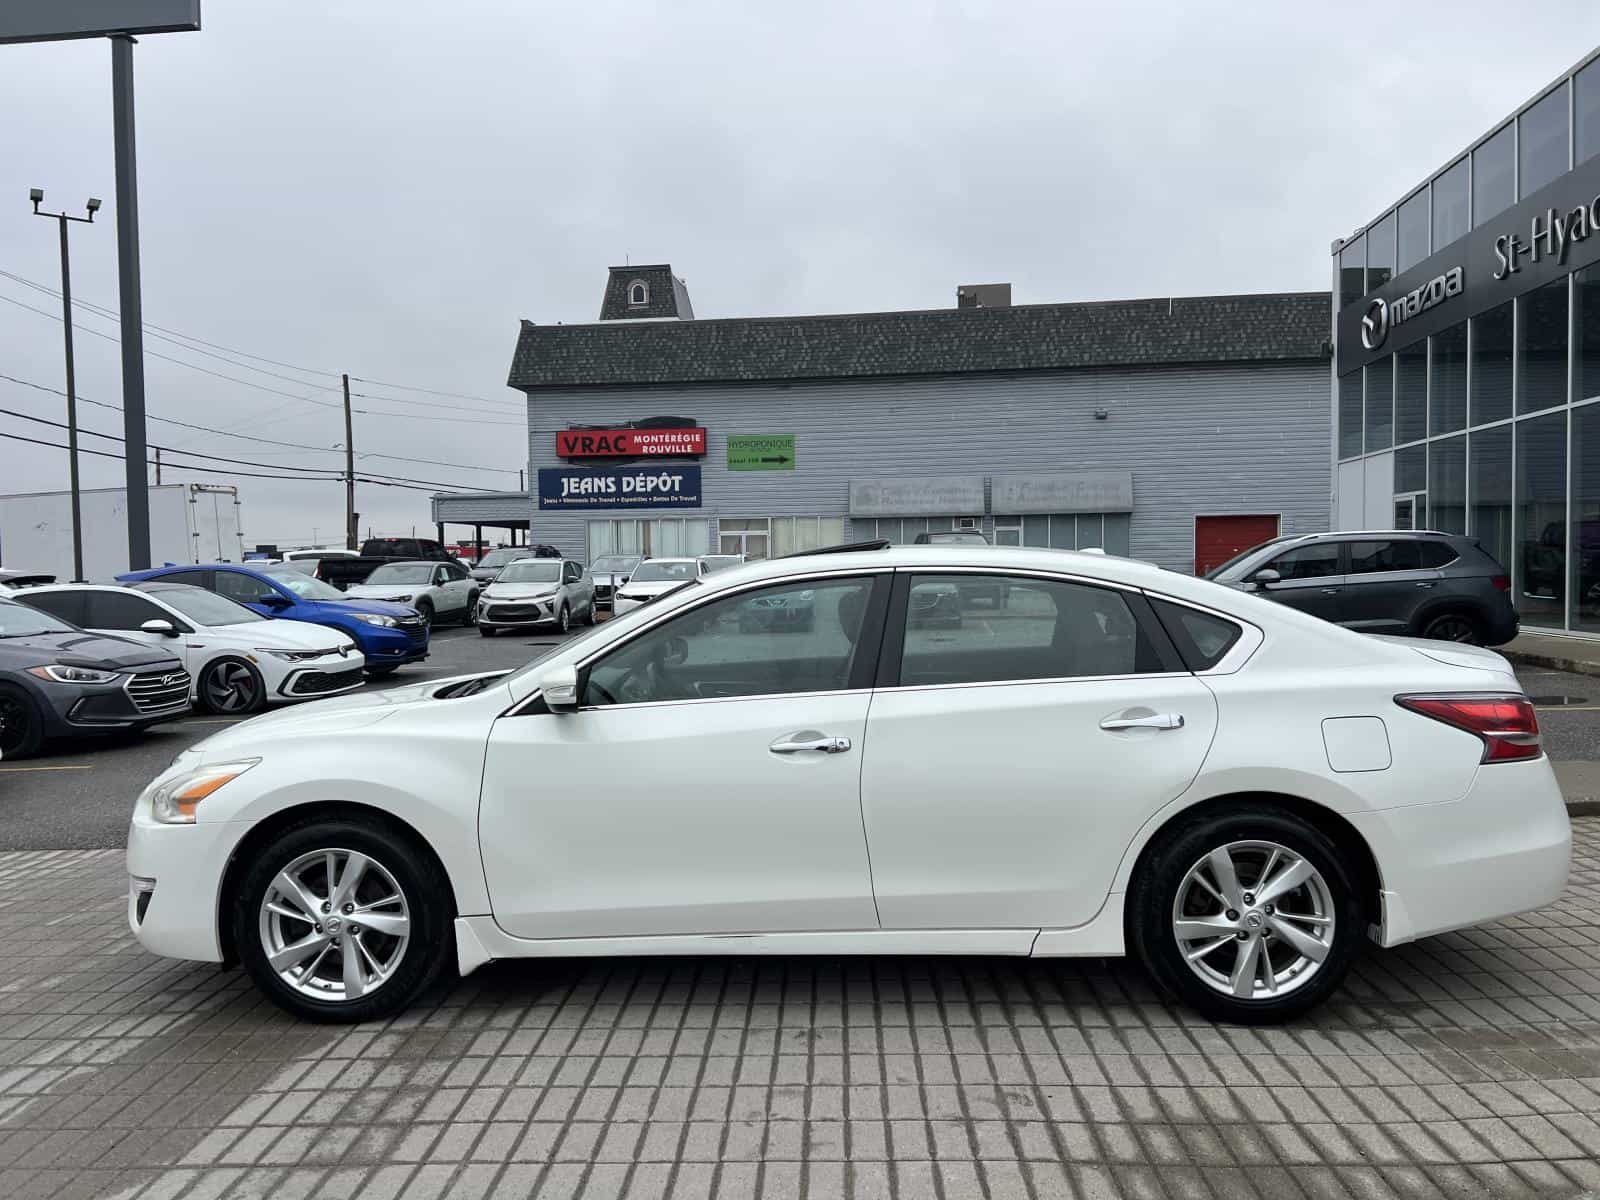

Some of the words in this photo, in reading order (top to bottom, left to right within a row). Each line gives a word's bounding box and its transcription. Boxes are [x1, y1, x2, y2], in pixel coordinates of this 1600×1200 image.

[1391, 266, 1462, 325] mazda
[563, 435, 627, 454] VRAC
[634, 433, 700, 443] MONTÉRÉGIE
[642, 444, 693, 454] ROUVILLE
[561, 477, 616, 496] JEANS
[622, 472, 683, 493] DÉPÔT
